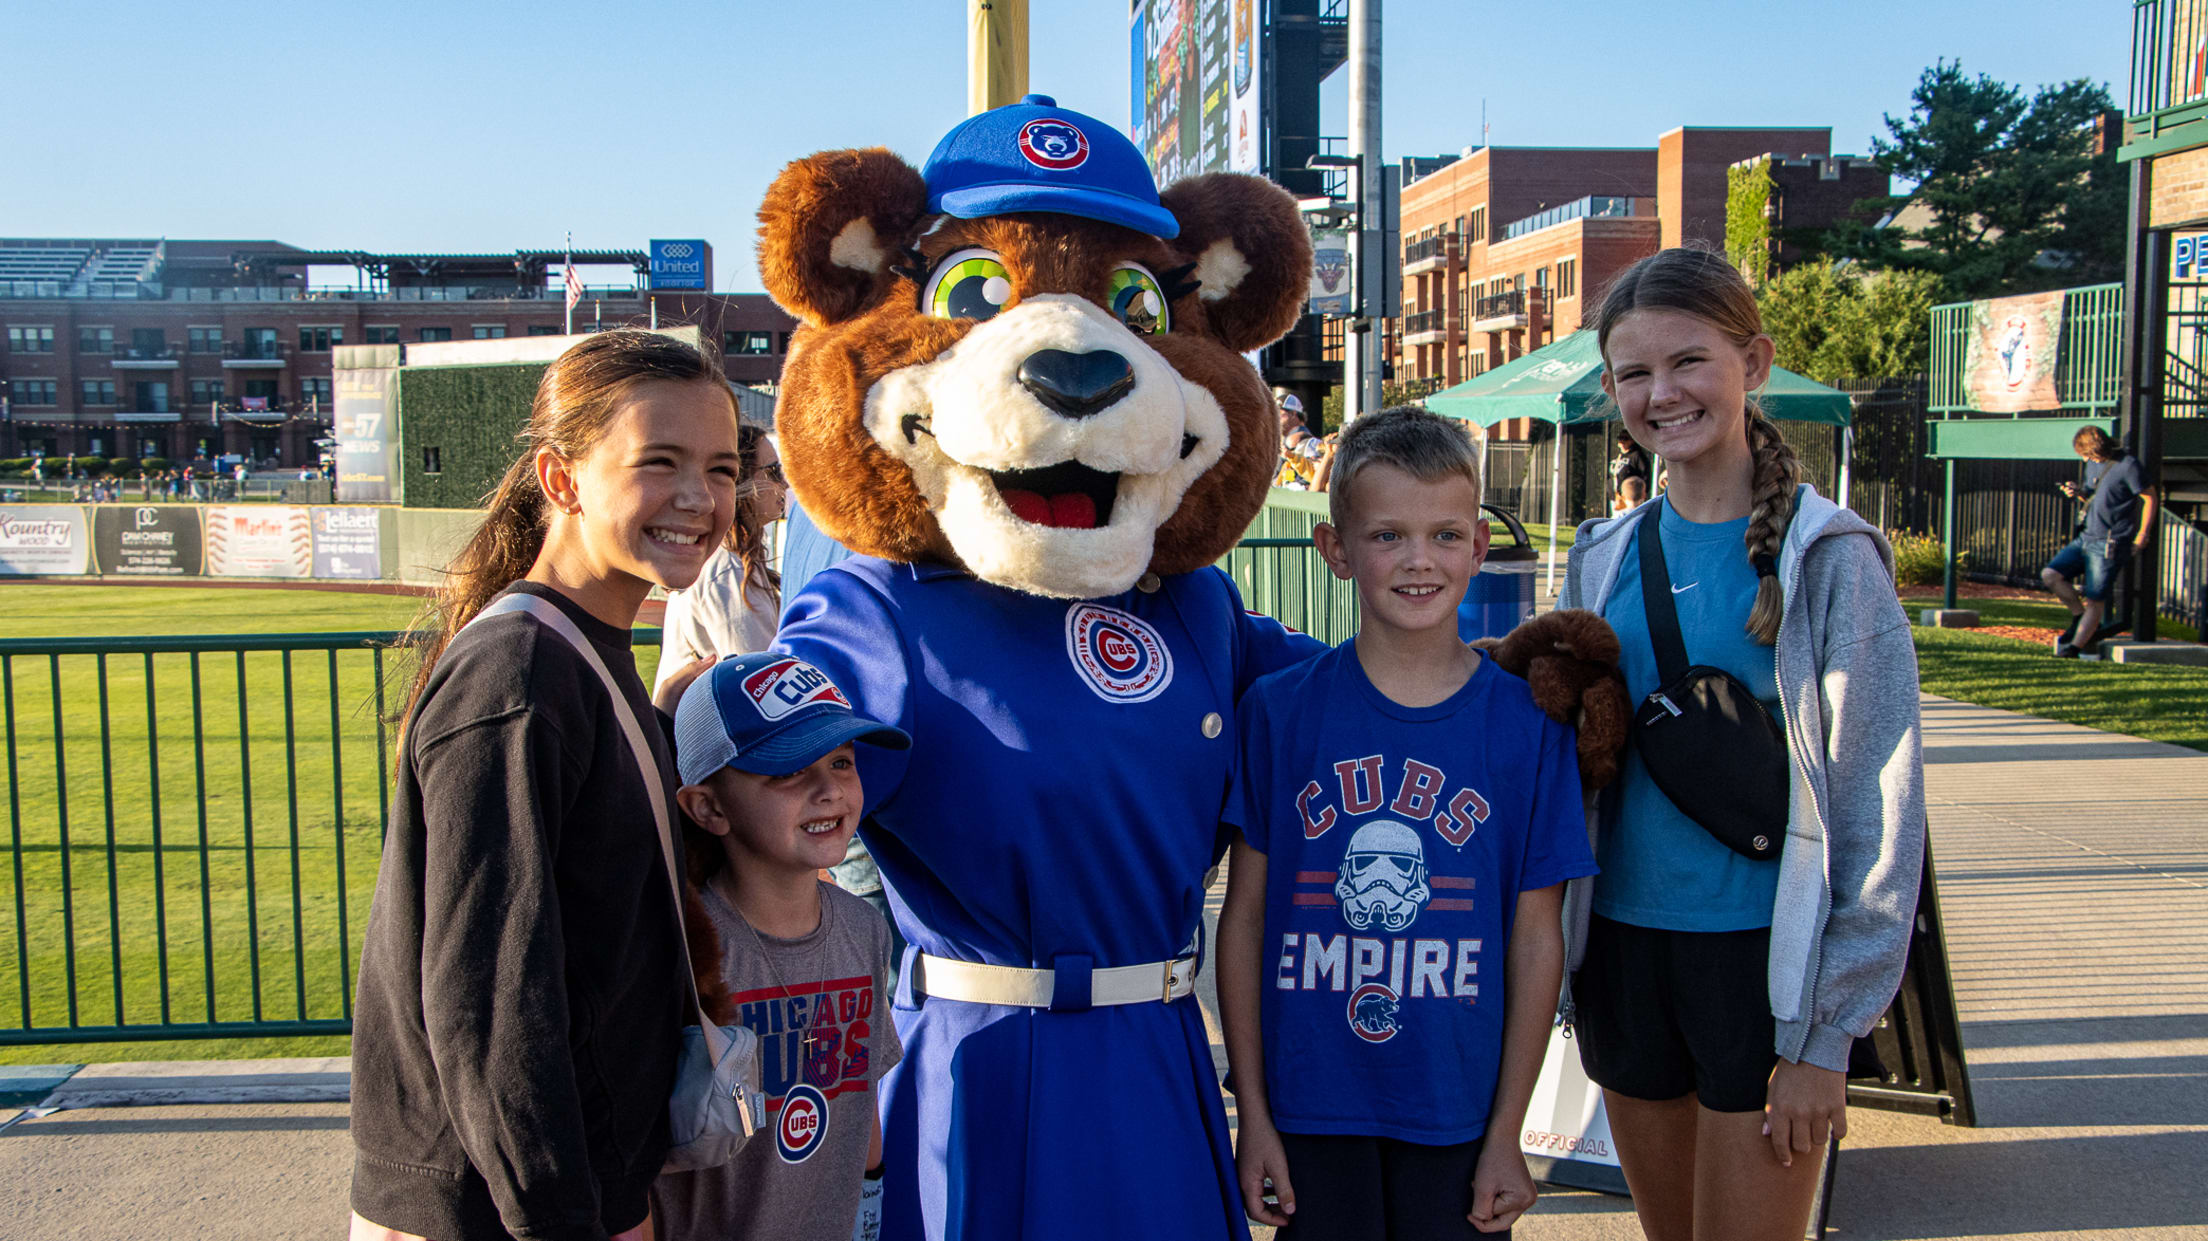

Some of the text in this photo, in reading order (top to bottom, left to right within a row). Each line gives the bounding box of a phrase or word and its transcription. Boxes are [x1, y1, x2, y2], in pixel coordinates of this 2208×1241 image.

[655, 260, 699, 273] United
[354, 413, 382, 438] 57
[342, 440, 381, 453] NEWS
[0, 512, 71, 546] Kountry
[1097, 628, 1140, 671] CUBS
[753, 671, 779, 698] Chicago
[773, 667, 828, 706] Cubs
[1296, 754, 1490, 845] CUBS
[1276, 932, 1482, 997] EMPIRE
[741, 988, 873, 1036] HICAGO
[762, 1020, 870, 1097] UBS
[782, 1099, 818, 1148] CUBS
[1524, 1131, 1608, 1156] OFFICIAL
